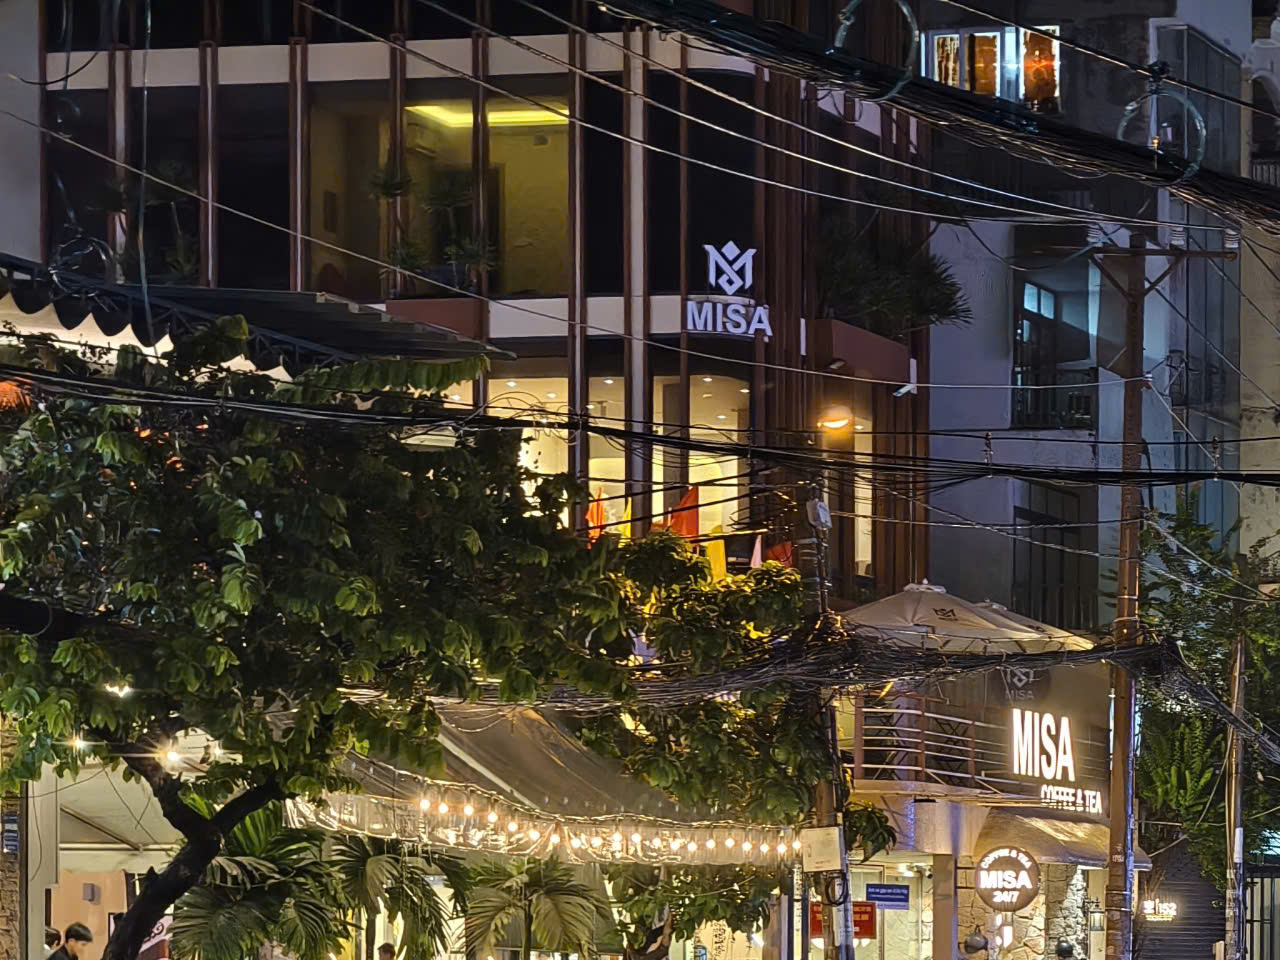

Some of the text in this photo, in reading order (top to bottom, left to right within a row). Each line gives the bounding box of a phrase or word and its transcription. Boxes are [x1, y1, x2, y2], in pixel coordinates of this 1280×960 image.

[687, 301, 773, 336] MISA
[1012, 707, 1076, 782] MISA
[1040, 783, 1076, 811] COFFEE
[1083, 789, 1102, 814] TEA
[979, 870, 1033, 889] MISA
[992, 890, 1020, 902] 24/7
